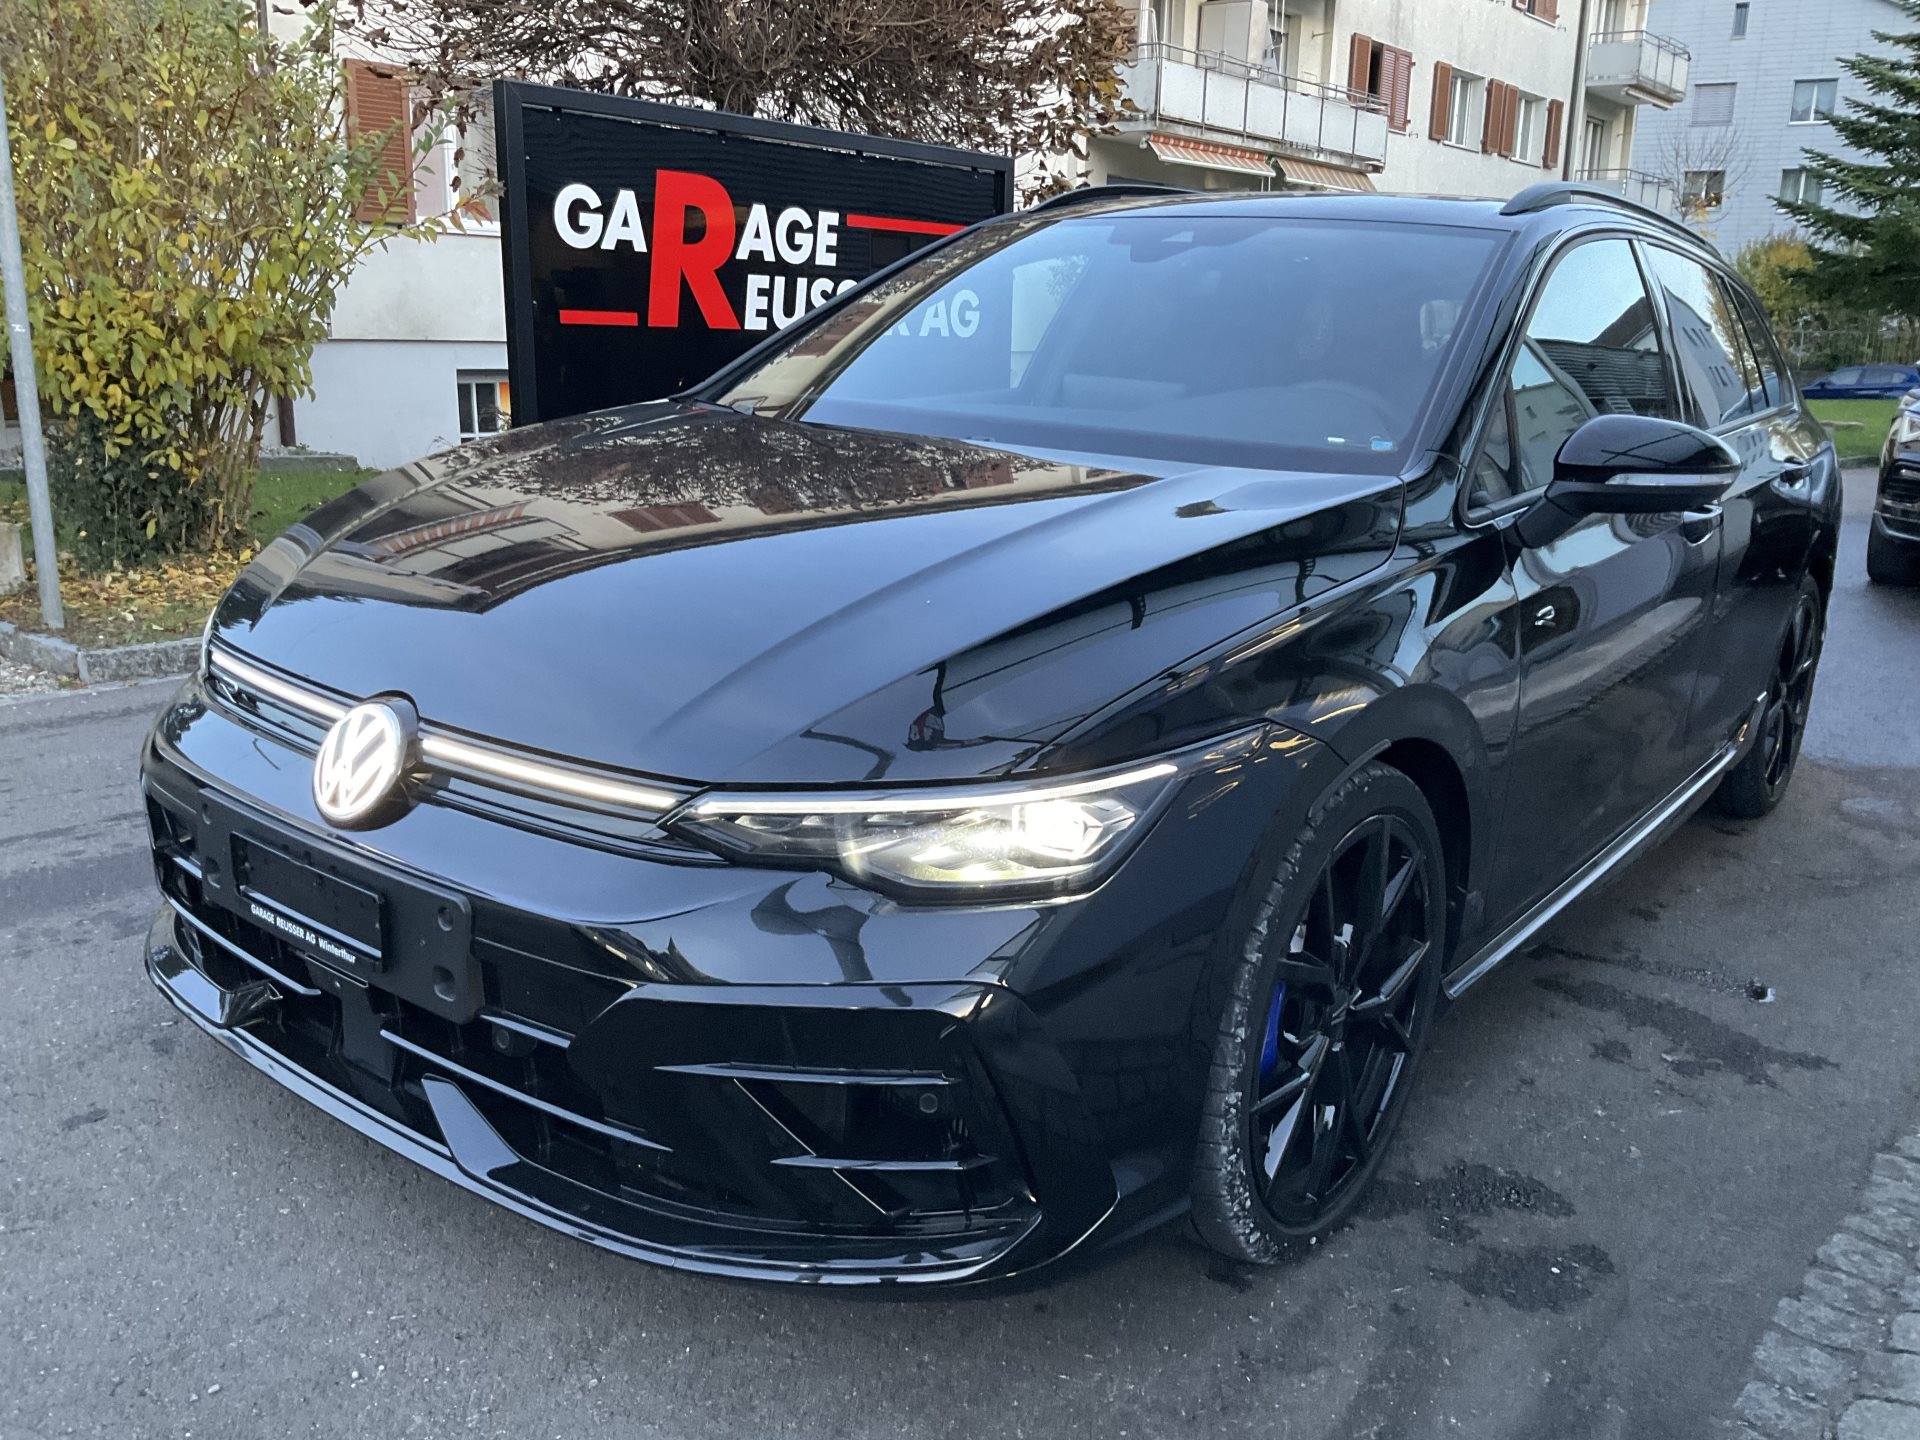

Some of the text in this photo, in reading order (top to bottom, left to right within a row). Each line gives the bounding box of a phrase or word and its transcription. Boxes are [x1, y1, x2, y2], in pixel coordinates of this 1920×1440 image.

[553, 168, 840, 330] GARAGE
[919, 288, 981, 339] AG
[251, 904, 356, 963] GARAGE REUSSER AG Winterthur
